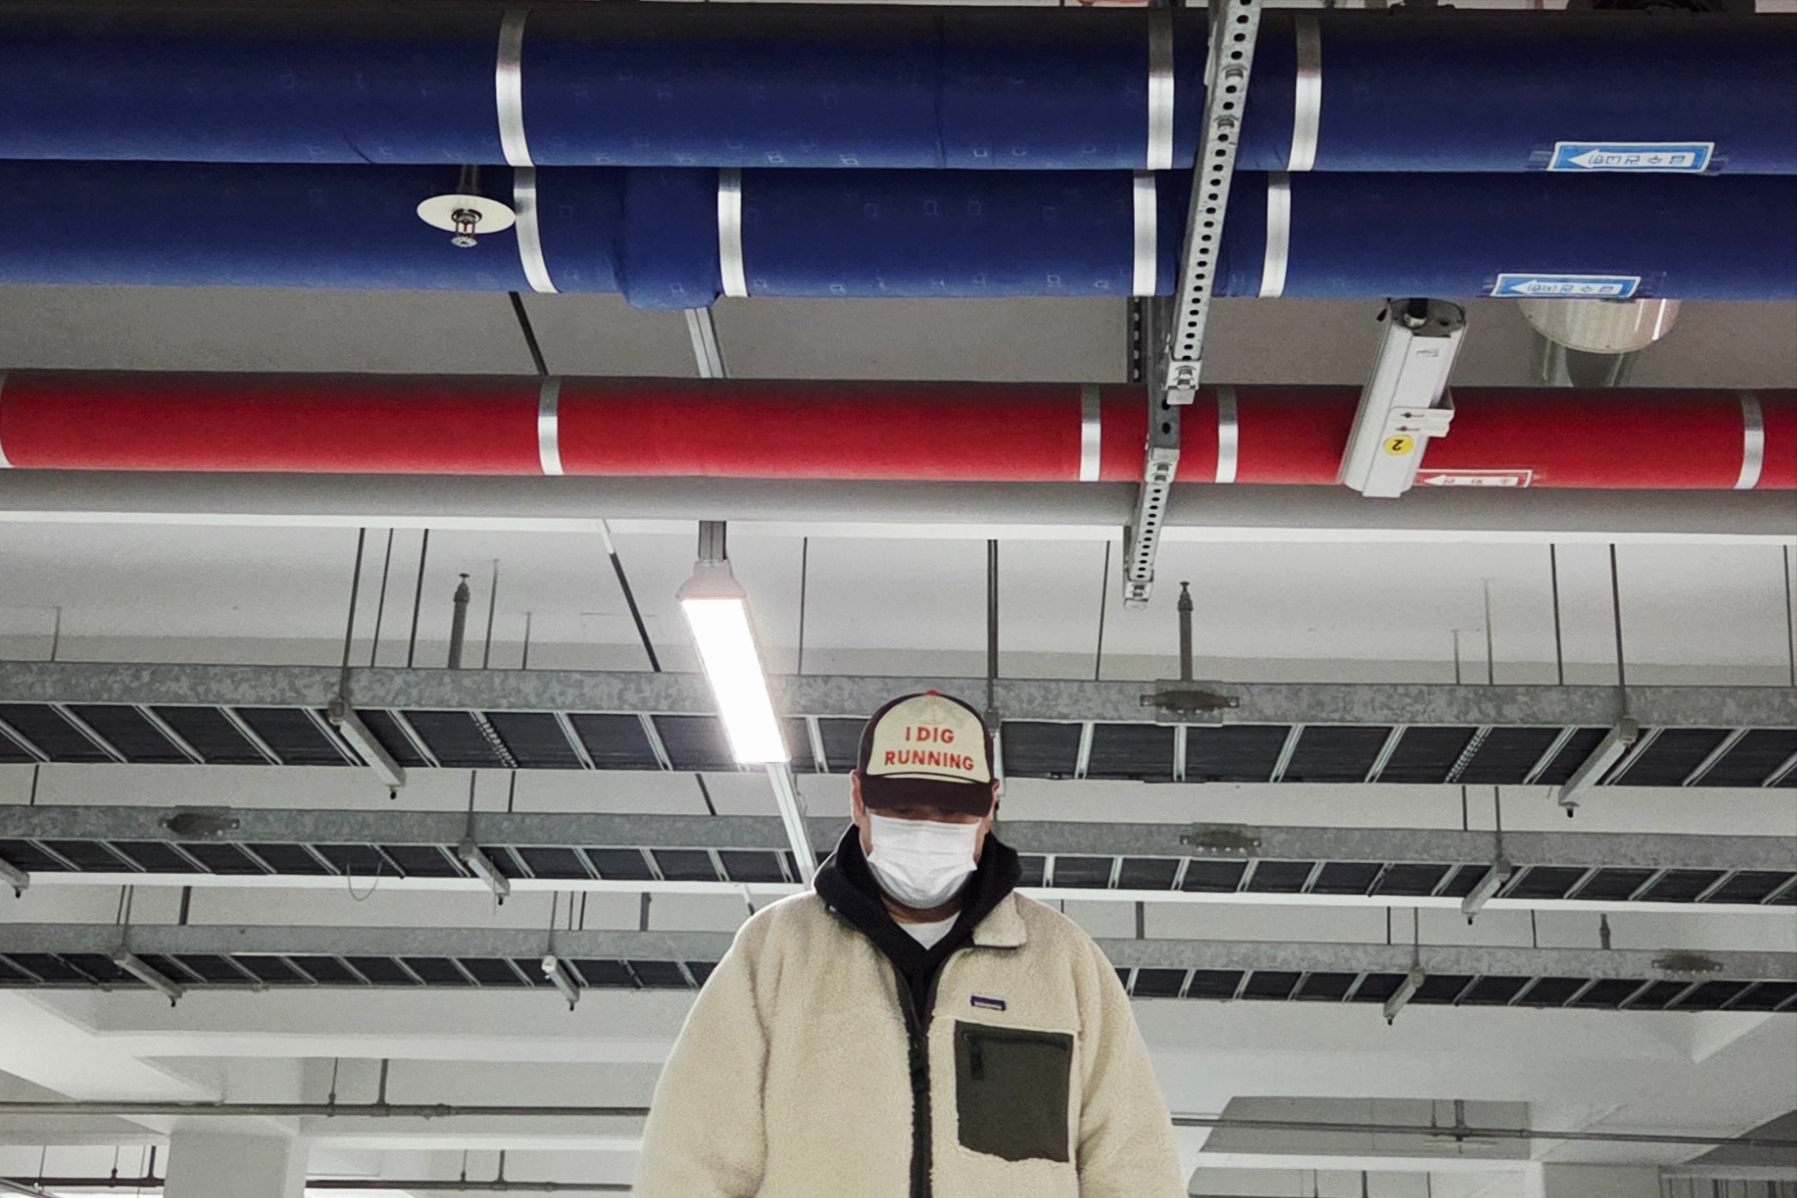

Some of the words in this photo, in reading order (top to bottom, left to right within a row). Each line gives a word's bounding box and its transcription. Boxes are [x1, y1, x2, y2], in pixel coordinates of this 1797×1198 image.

[1392, 439, 1404, 451] 2
[905, 726, 911, 742] I
[917, 726, 955, 744] DIG
[884, 749, 974, 771] RUNNING
